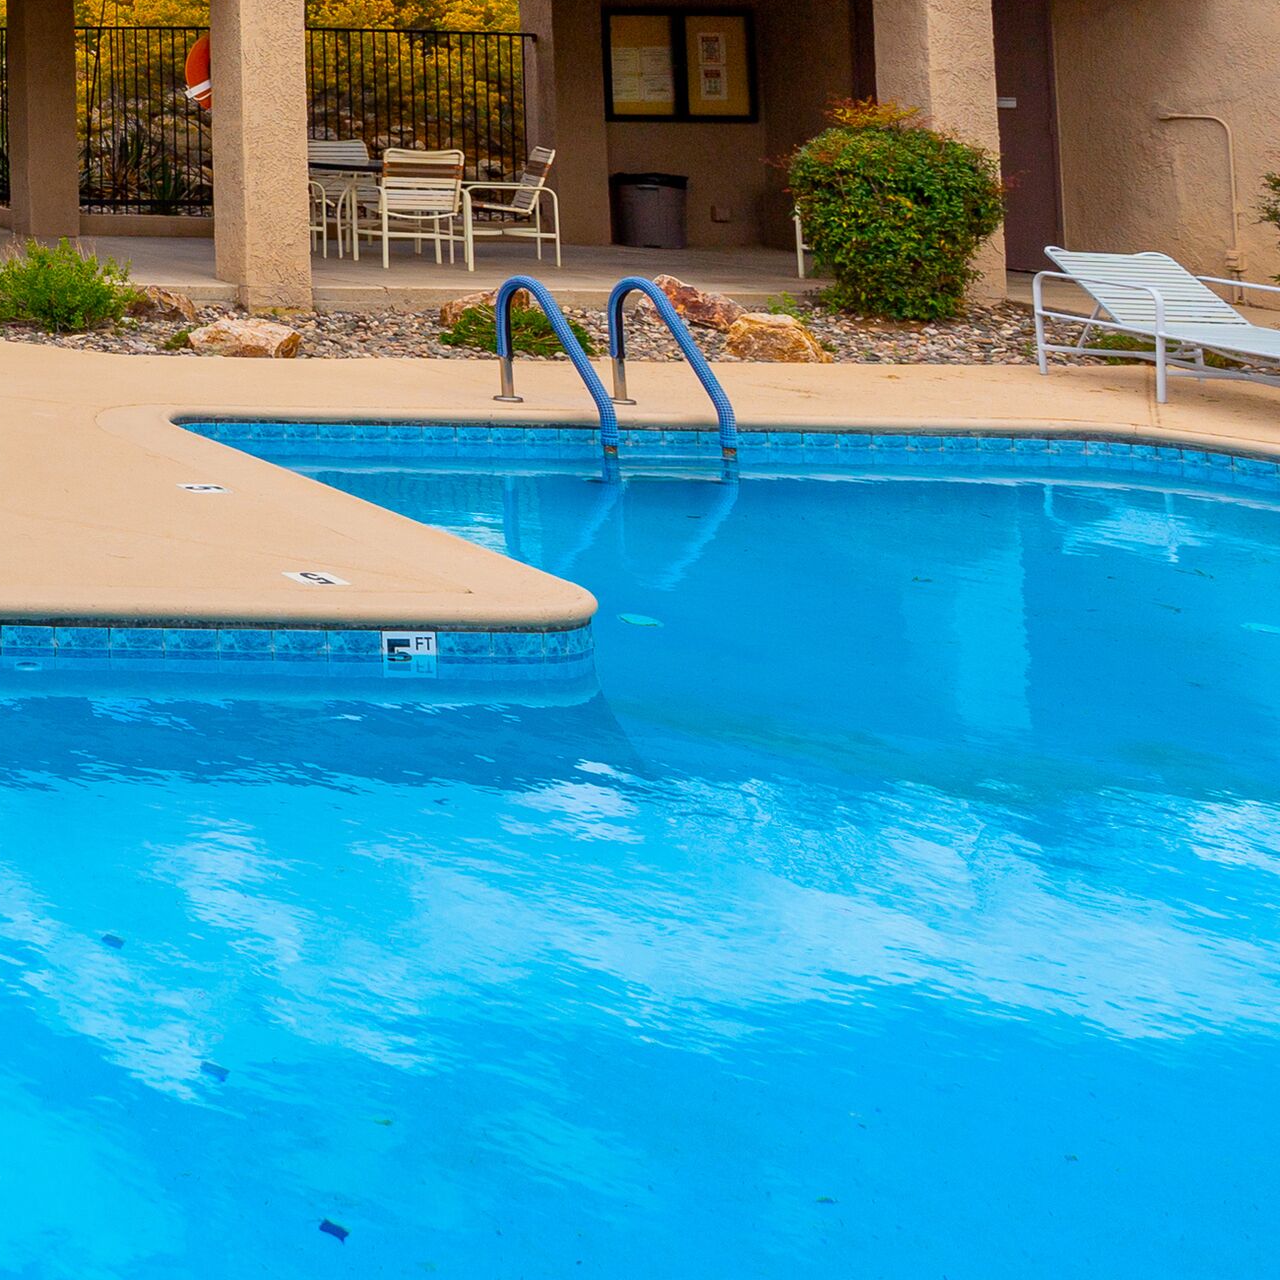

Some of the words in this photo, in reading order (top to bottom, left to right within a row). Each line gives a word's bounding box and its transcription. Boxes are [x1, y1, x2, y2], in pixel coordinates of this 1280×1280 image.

[299, 571, 336, 585] 5
[386, 638, 413, 662] 5
[415, 636, 433, 651] FT
